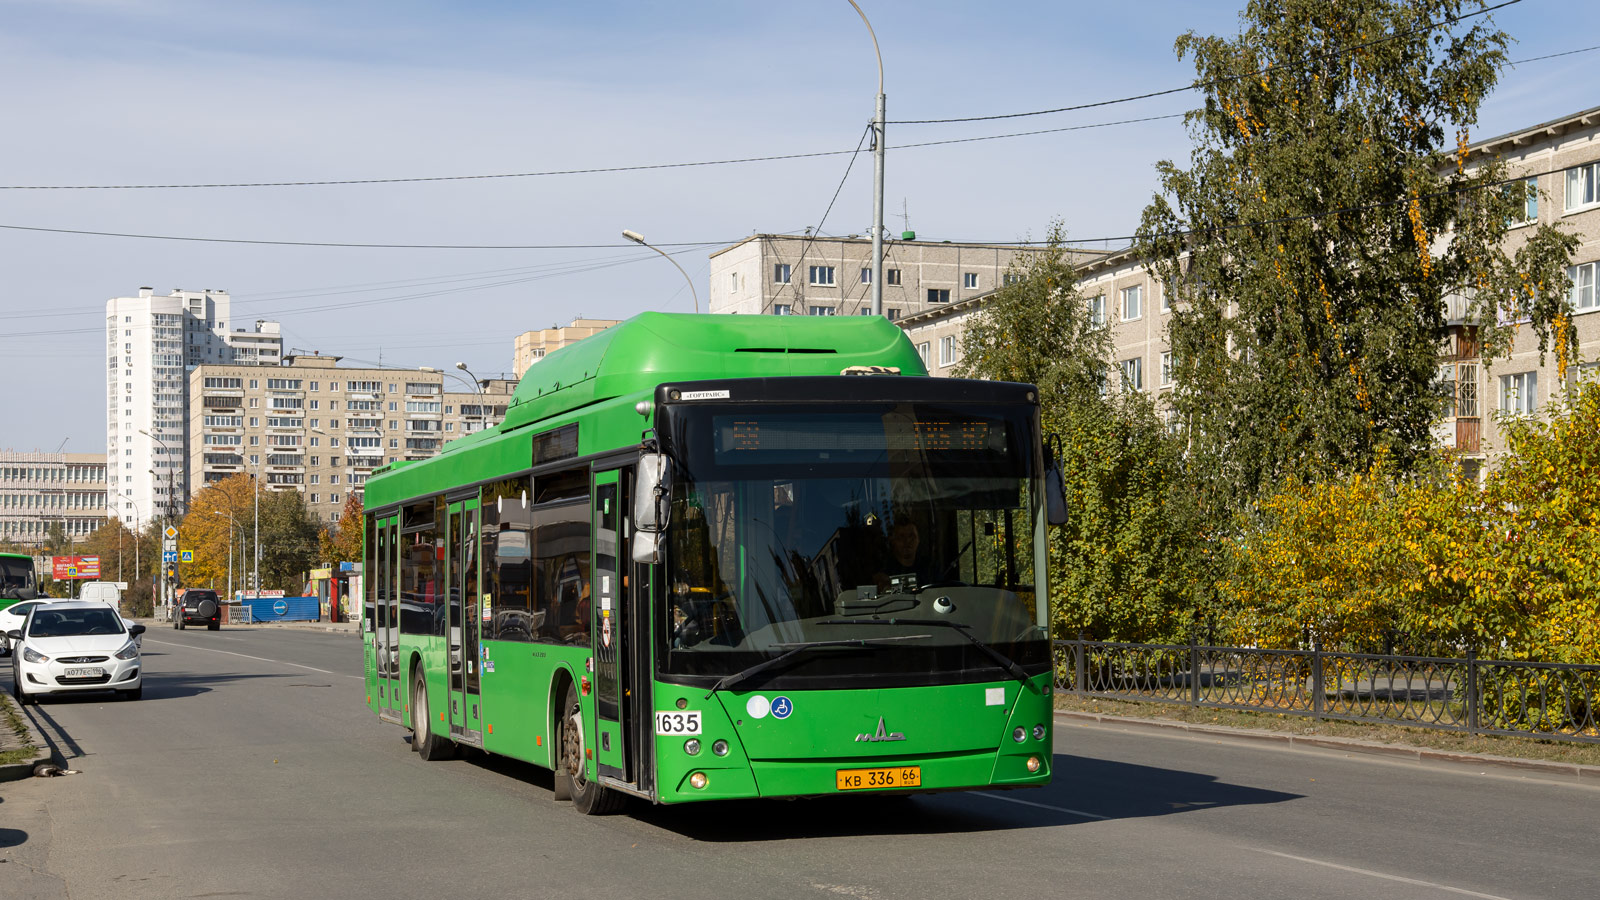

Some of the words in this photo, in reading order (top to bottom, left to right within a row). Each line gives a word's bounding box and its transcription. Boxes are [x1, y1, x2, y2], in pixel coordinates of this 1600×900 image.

[656, 713, 699, 733] 1635
[868, 771, 894, 786] 336
[902, 769, 916, 780] 66
